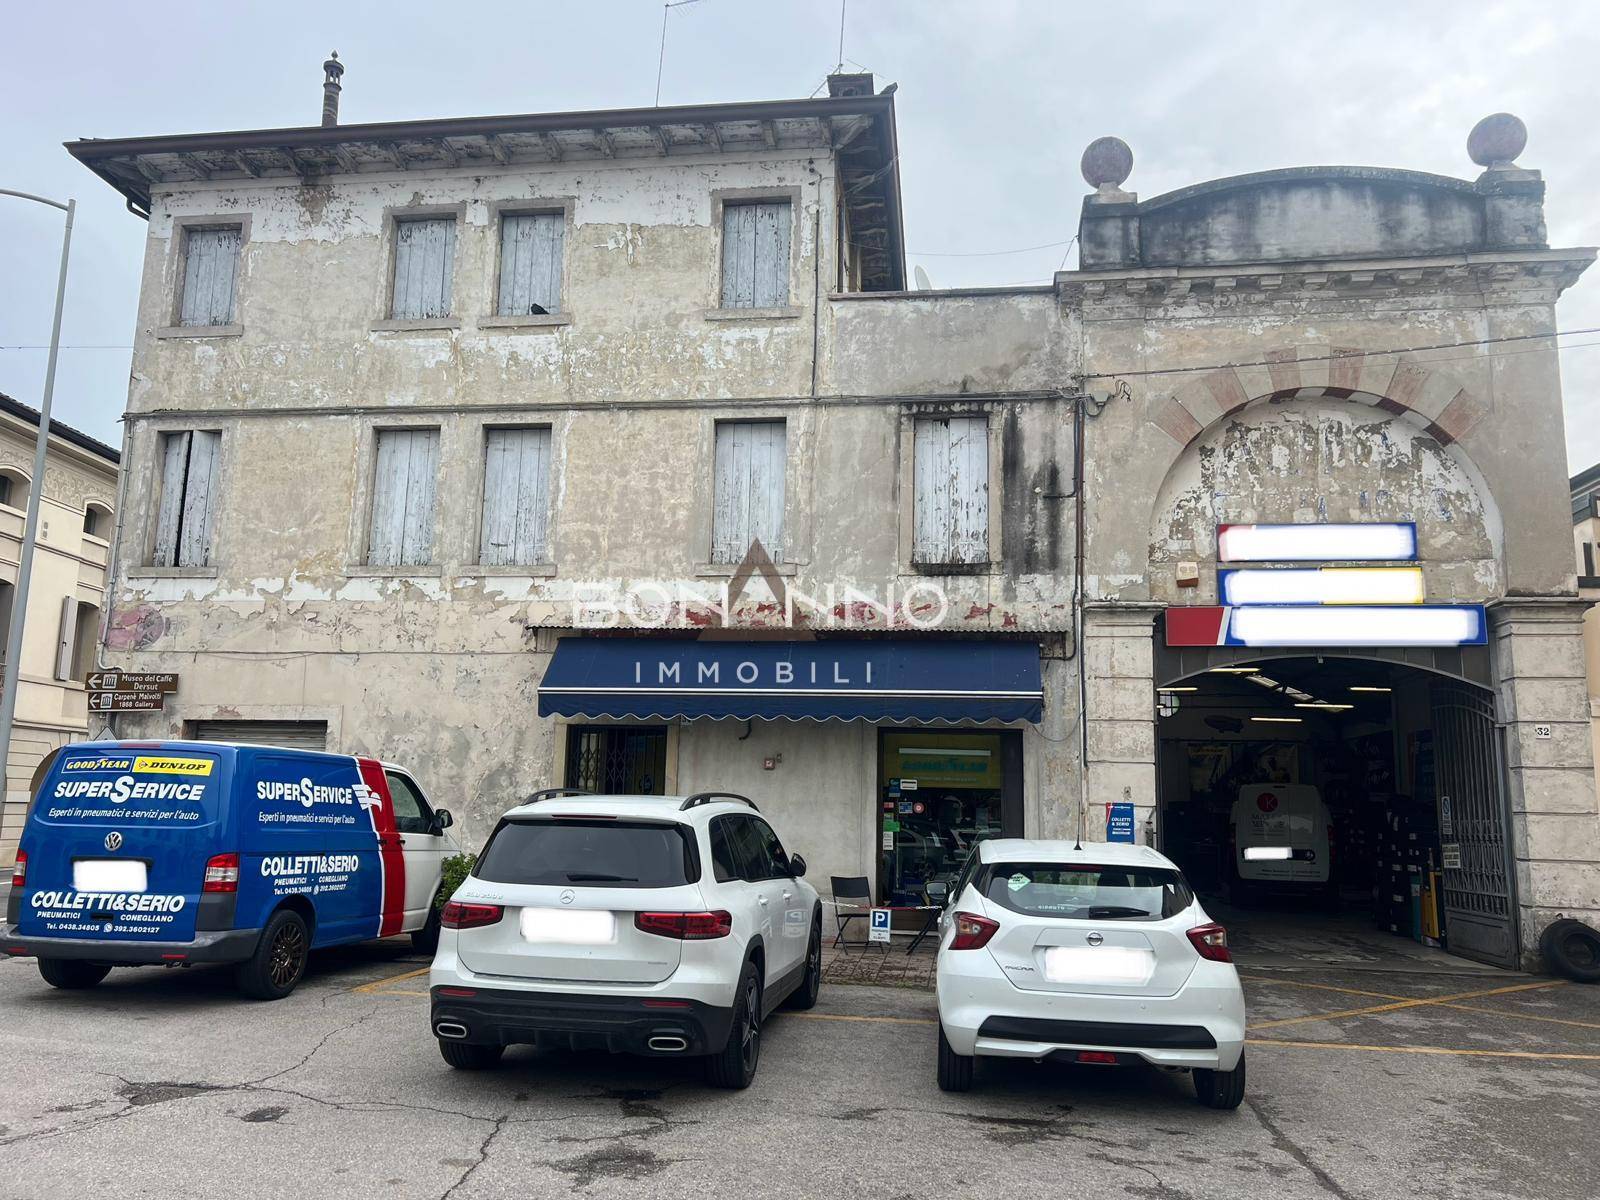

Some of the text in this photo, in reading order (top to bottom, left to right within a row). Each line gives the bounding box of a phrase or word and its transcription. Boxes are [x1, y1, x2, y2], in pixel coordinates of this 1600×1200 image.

[121, 674, 143, 682] Museo
[145, 674, 155, 682] del
[134, 682, 158, 691] Dersut
[114, 693, 137, 701] Carpenè
[135, 701, 154, 709] Gallery
[1537, 727, 1550, 736] 32
[66, 757, 130, 770] GOODYEAR
[150, 761, 206, 771] DUNLOP
[54, 775, 206, 803] SUPERSERVICE
[257, 777, 353, 808] SUPERSERVICE
[49, 808, 74, 818] Esperti
[74, 808, 81, 817] in
[81, 808, 125, 819] pneumatici
[131, 809, 158, 819] servizi
[159, 812, 173, 822] per
[174, 810, 200, 821] l'auto
[259, 811, 280, 824] Esperti
[280, 812, 286, 822] in
[286, 813, 315, 824] pneumatici
[318, 814, 334, 823] servizi
[334, 815, 342, 825] per
[261, 855, 359, 876] COLLETTI&SERIO
[274, 877, 307, 886] PNEUMATICI
[318, 875, 348, 883] CONEGLIANO
[31, 891, 185, 912] COLLETTI&SERIO
[37, 911, 174, 923] PNEUMATICI CONEGLIANO
[875, 912, 886, 926] P
[58, 923, 100, 931] 0438.34805
[114, 925, 160, 933] 392.3602127
